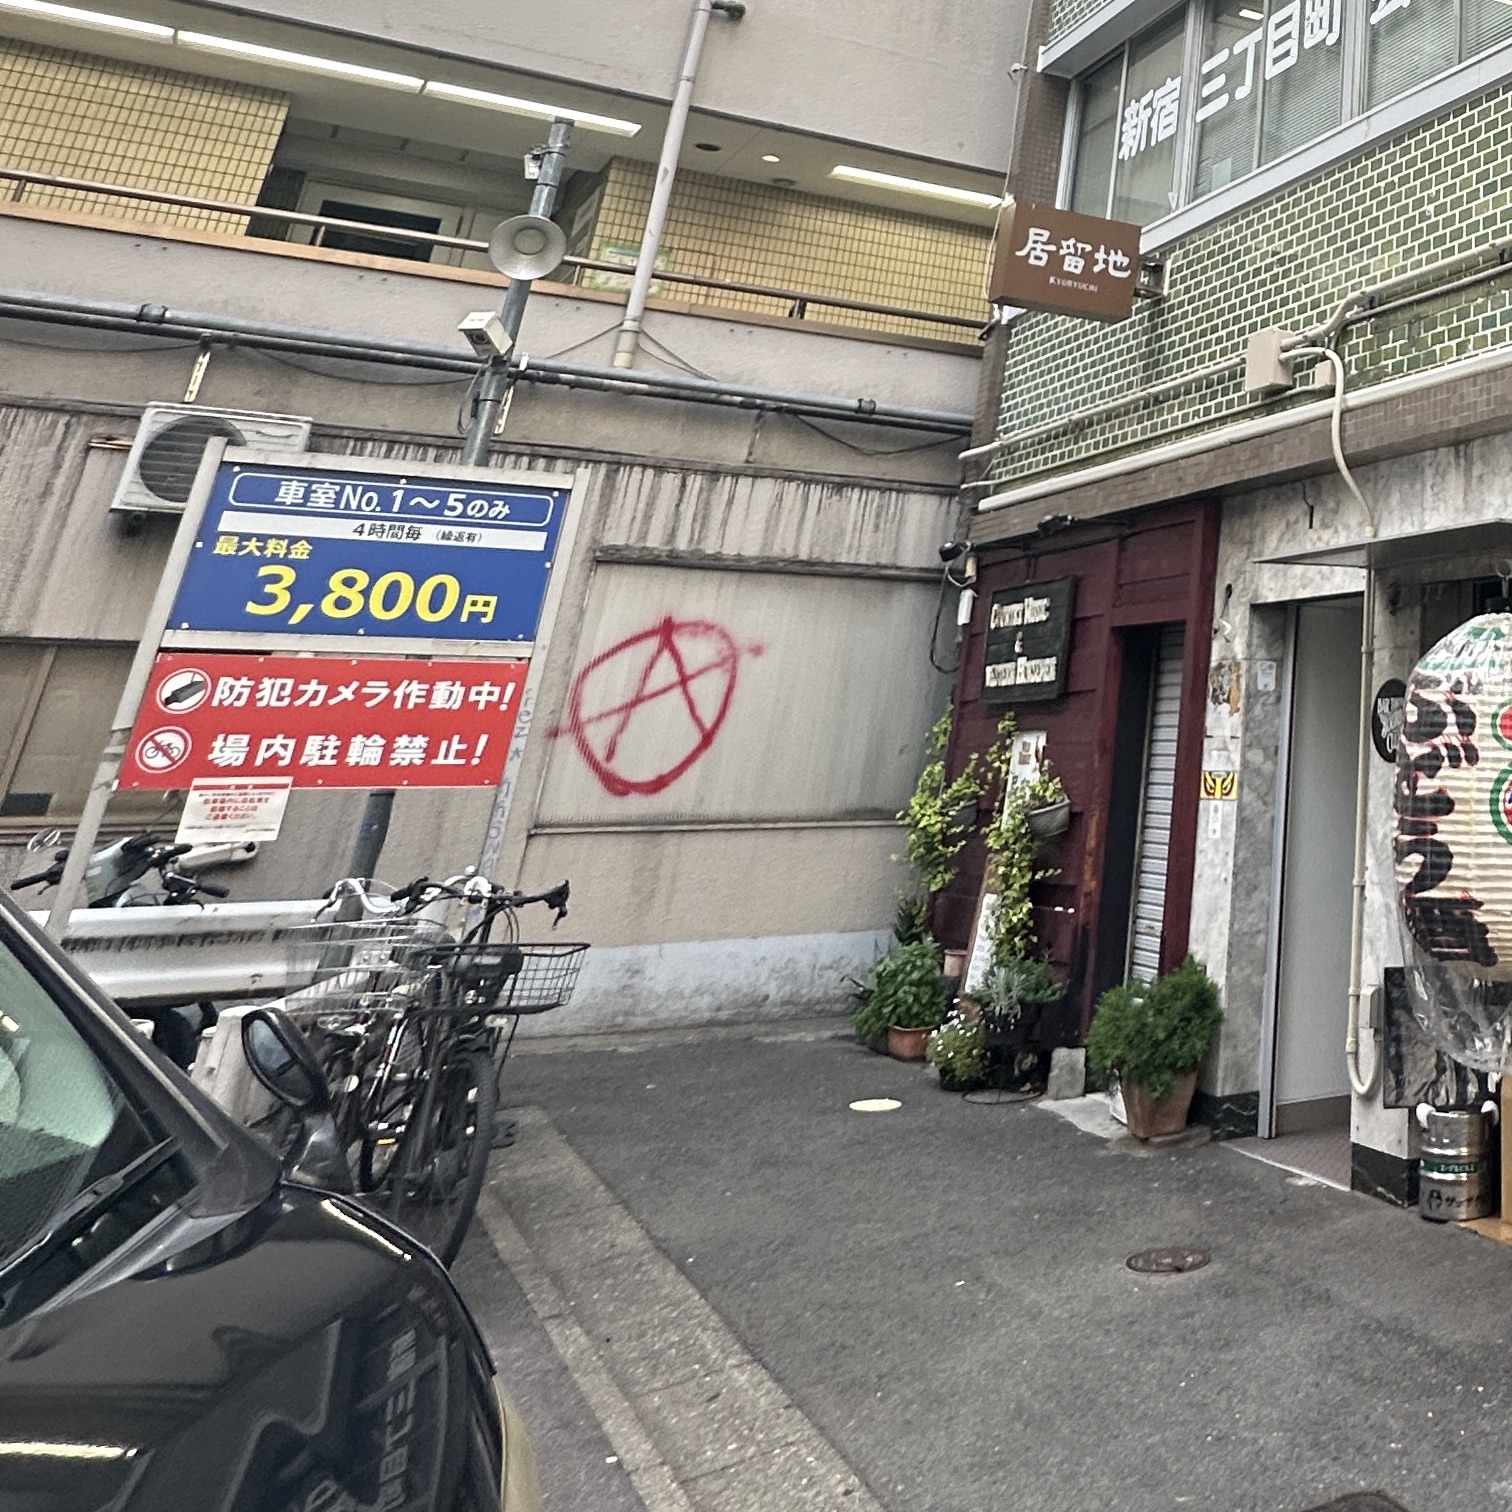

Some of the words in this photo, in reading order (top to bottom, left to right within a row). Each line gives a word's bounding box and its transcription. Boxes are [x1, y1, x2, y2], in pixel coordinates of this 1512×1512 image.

[1015, 227, 1132, 278] 居留地
[213, 536, 313, 559] 最大料金
[352, 523, 423, 541] 4時間毎
[245, 564, 498, 625] 3,800円
